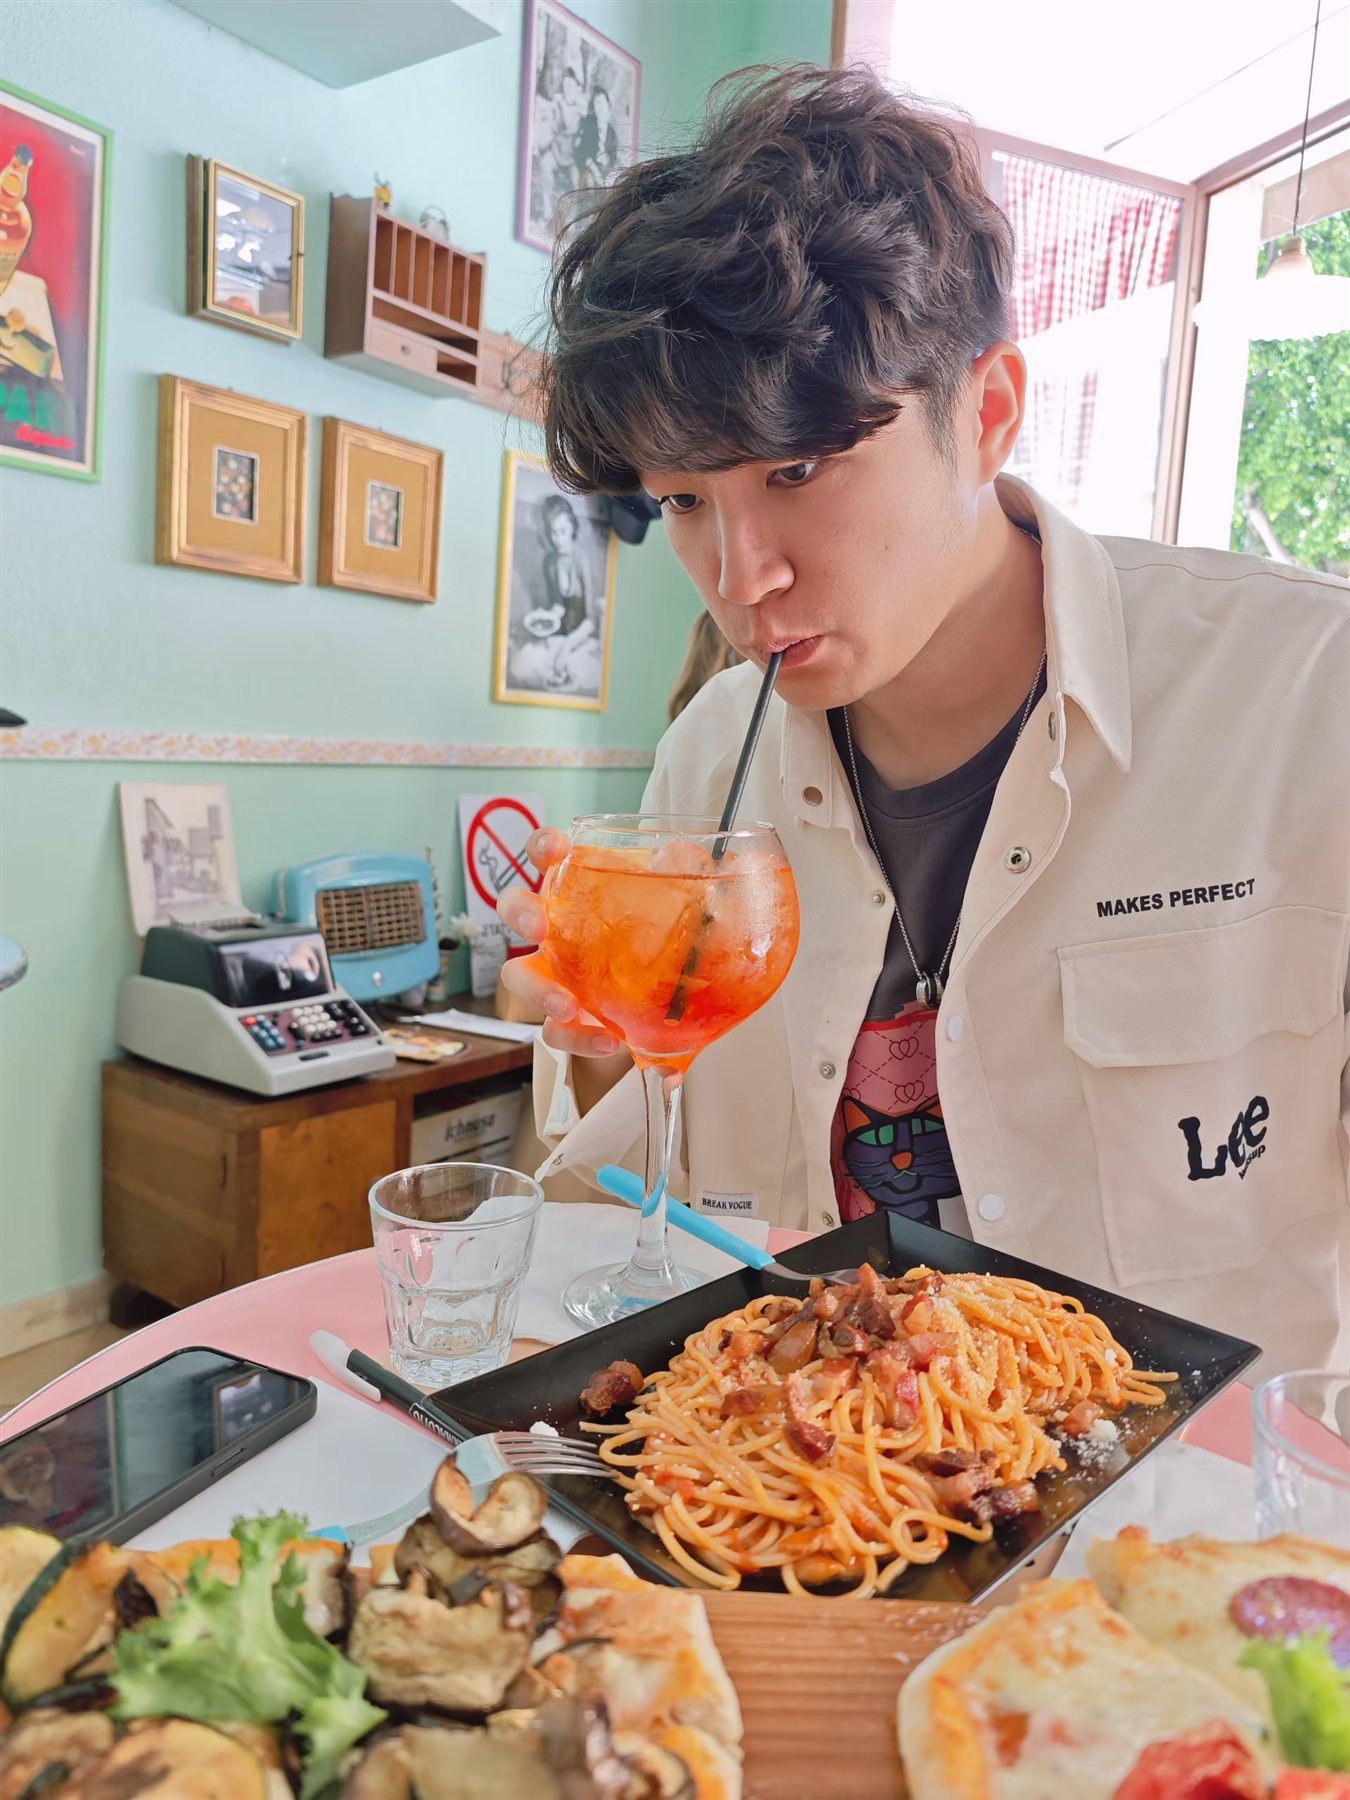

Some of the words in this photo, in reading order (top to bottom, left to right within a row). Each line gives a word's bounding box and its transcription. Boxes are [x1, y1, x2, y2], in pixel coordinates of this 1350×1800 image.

[1096, 893, 1164, 918] MAKES
[1169, 878, 1255, 908] PERFECT
[1178, 1095, 1269, 1181] Lee
[702, 1197, 727, 1210] BREAK
[728, 1200, 753, 1210] VOGUE
